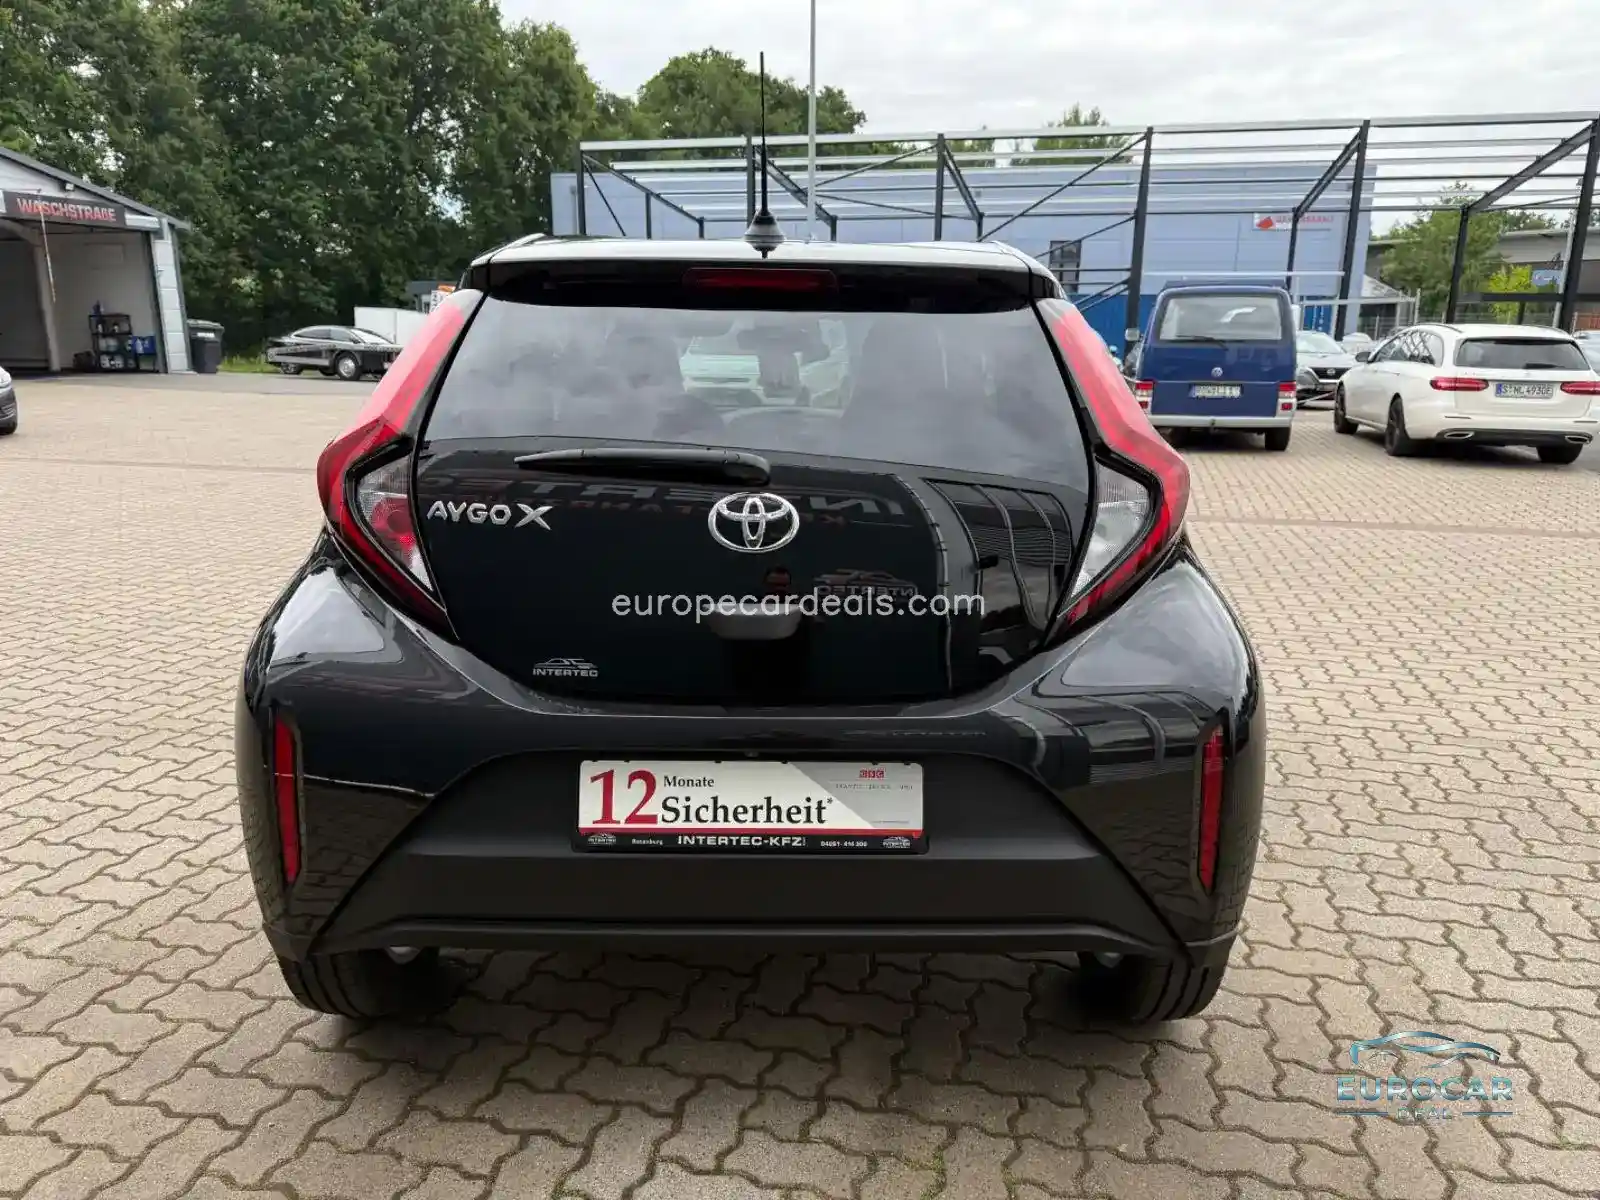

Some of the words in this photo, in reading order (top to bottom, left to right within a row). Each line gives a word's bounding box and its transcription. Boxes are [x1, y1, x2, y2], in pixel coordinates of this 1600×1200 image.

[426, 500, 512, 525] AYGO
[515, 503, 553, 530] X
[532, 668, 599, 677] INTERTEC
[664, 776, 715, 787] Monate
[590, 768, 658, 824] 12
